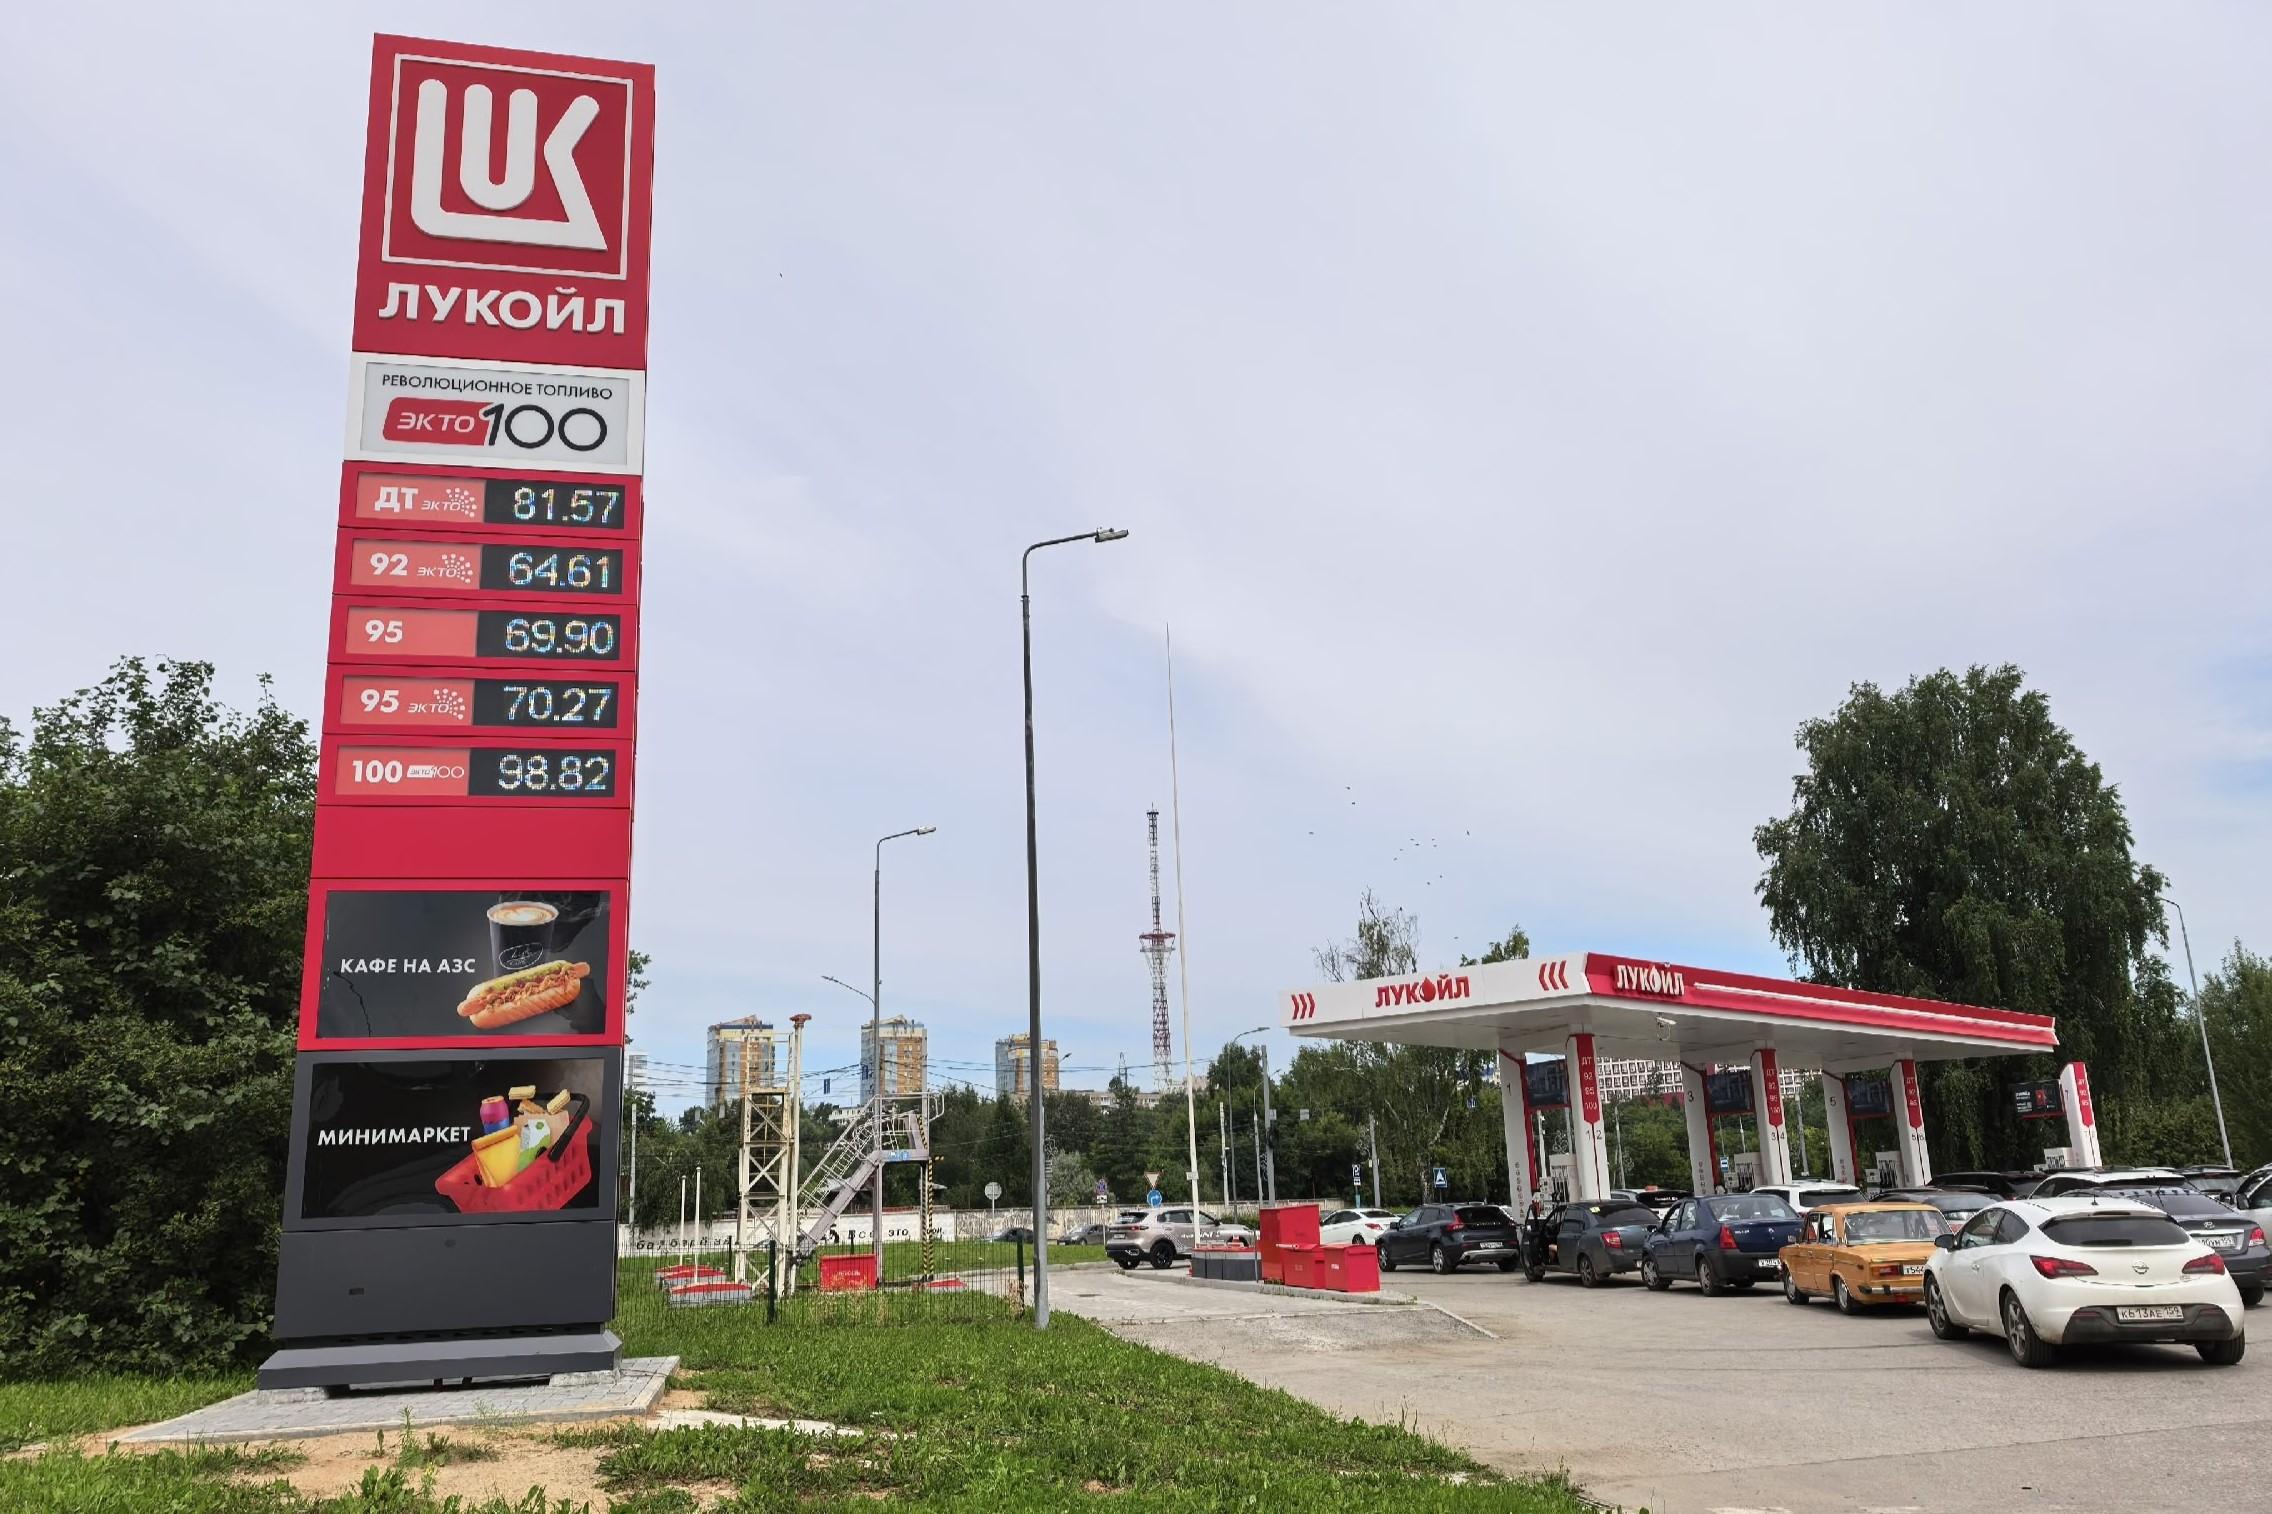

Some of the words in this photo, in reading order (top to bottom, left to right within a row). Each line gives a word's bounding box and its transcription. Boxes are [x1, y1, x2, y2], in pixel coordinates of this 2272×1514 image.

[378, 282, 625, 334] ЛУКОЙЛ
[382, 374, 533, 396] РЕВОЛЮЦИОННОЕ
[537, 383, 613, 400] ТОПЛИВО
[397, 411, 475, 433] ЭКТО
[480, 403, 608, 451] 100
[374, 486, 419, 512] ДТ
[514, 487, 619, 523] 81.57
[369, 553, 409, 576] 92
[508, 552, 609, 588] 64.61
[365, 620, 403, 643] 95
[505, 618, 614, 654] 69.90
[360, 689, 399, 713] 95
[503, 686, 611, 721] 70.27
[352, 760, 403, 783] 100
[499, 755, 610, 790] 98.82
[340, 958, 397, 974] КАФЕ
[403, 958, 431, 973] НА
[436, 958, 476, 973] АЗС
[1616, 961, 1685, 996] ЛУКОЙЛ
[1375, 974, 1470, 1008] ЛУКОЙЛ
[1687, 1090, 1695, 1102] 3
[1830, 1096, 1837, 1107] 5
[317, 1126, 472, 1146] МИНИМАРКЕТ
[1596, 1129, 1602, 1140] 2
[1771, 1132, 1777, 1141] 3
[1780, 1132, 1785, 1140] 4
